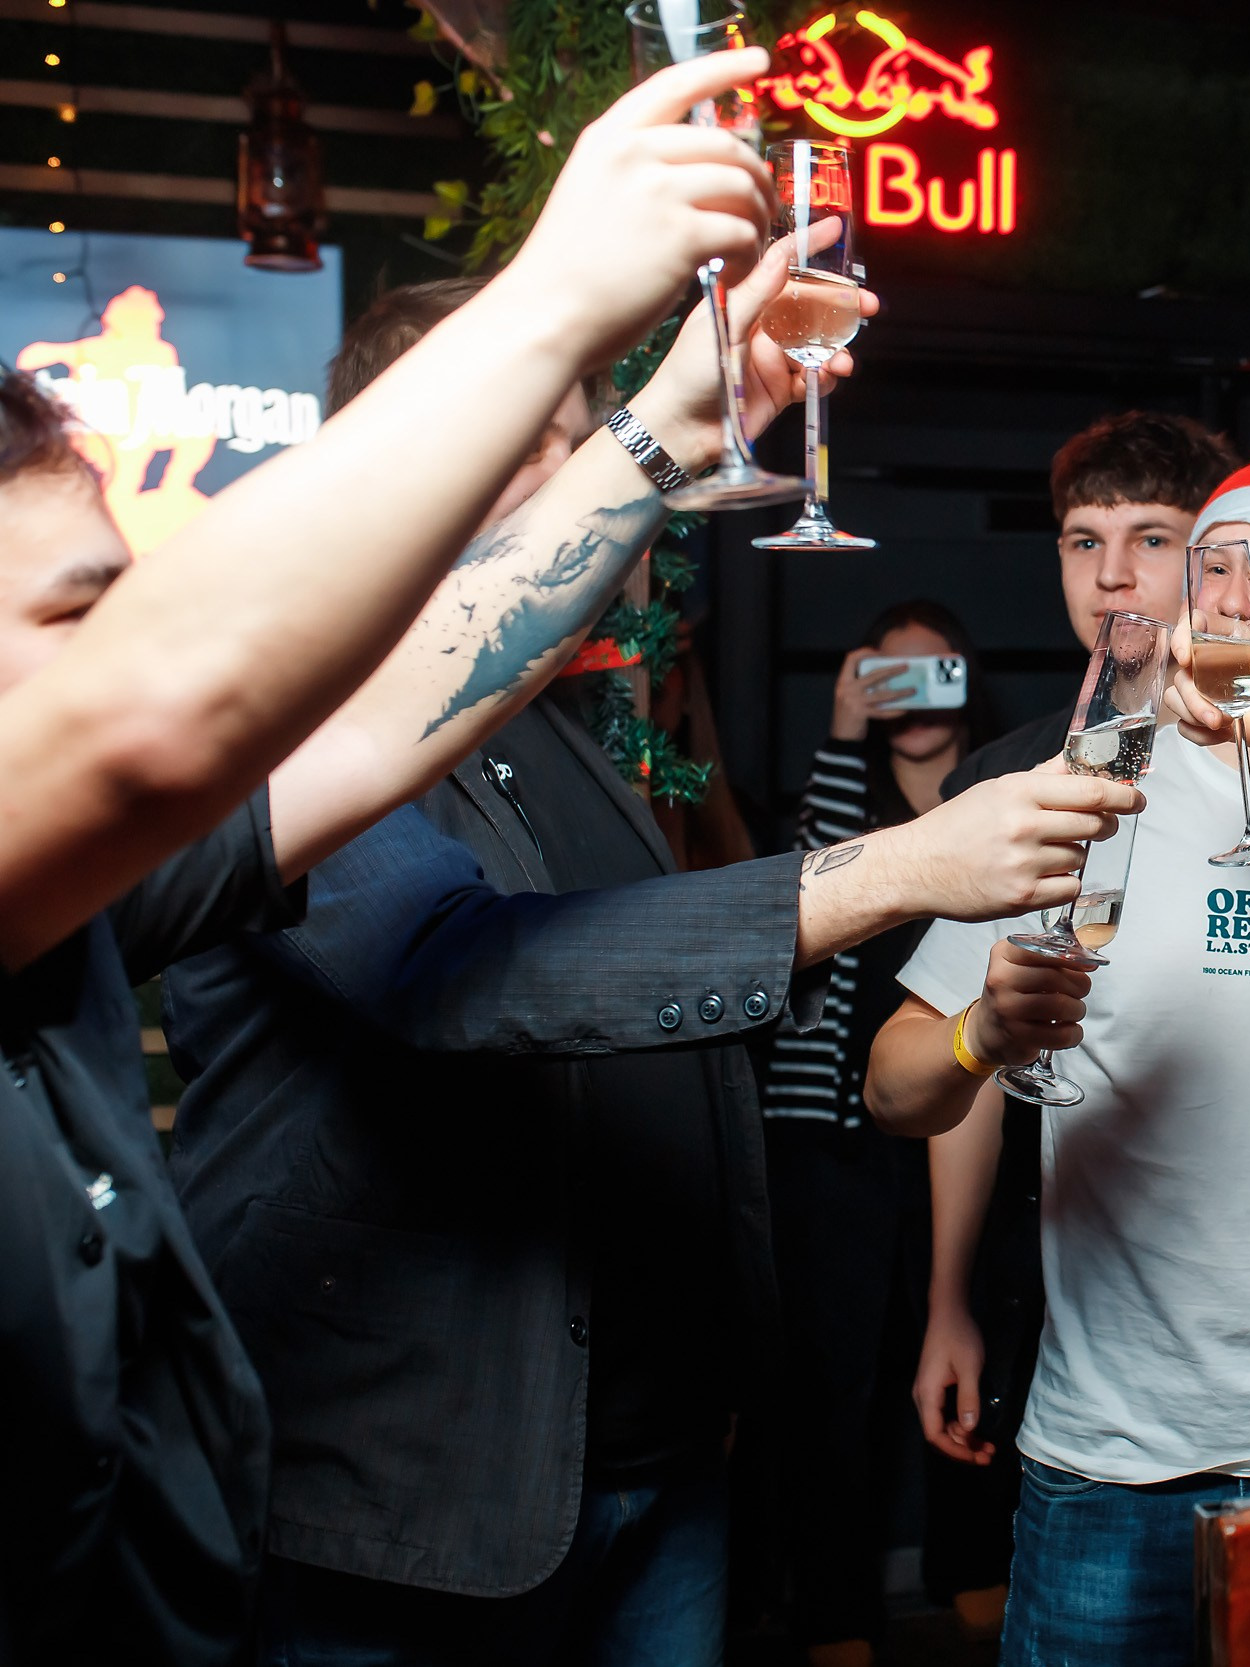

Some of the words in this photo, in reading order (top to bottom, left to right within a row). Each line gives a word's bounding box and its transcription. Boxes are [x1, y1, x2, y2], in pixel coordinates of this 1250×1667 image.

[865, 143, 1017, 234] Bull
[124, 363, 321, 453] Morgan
[1217, 968, 1243, 977] OCEAN
